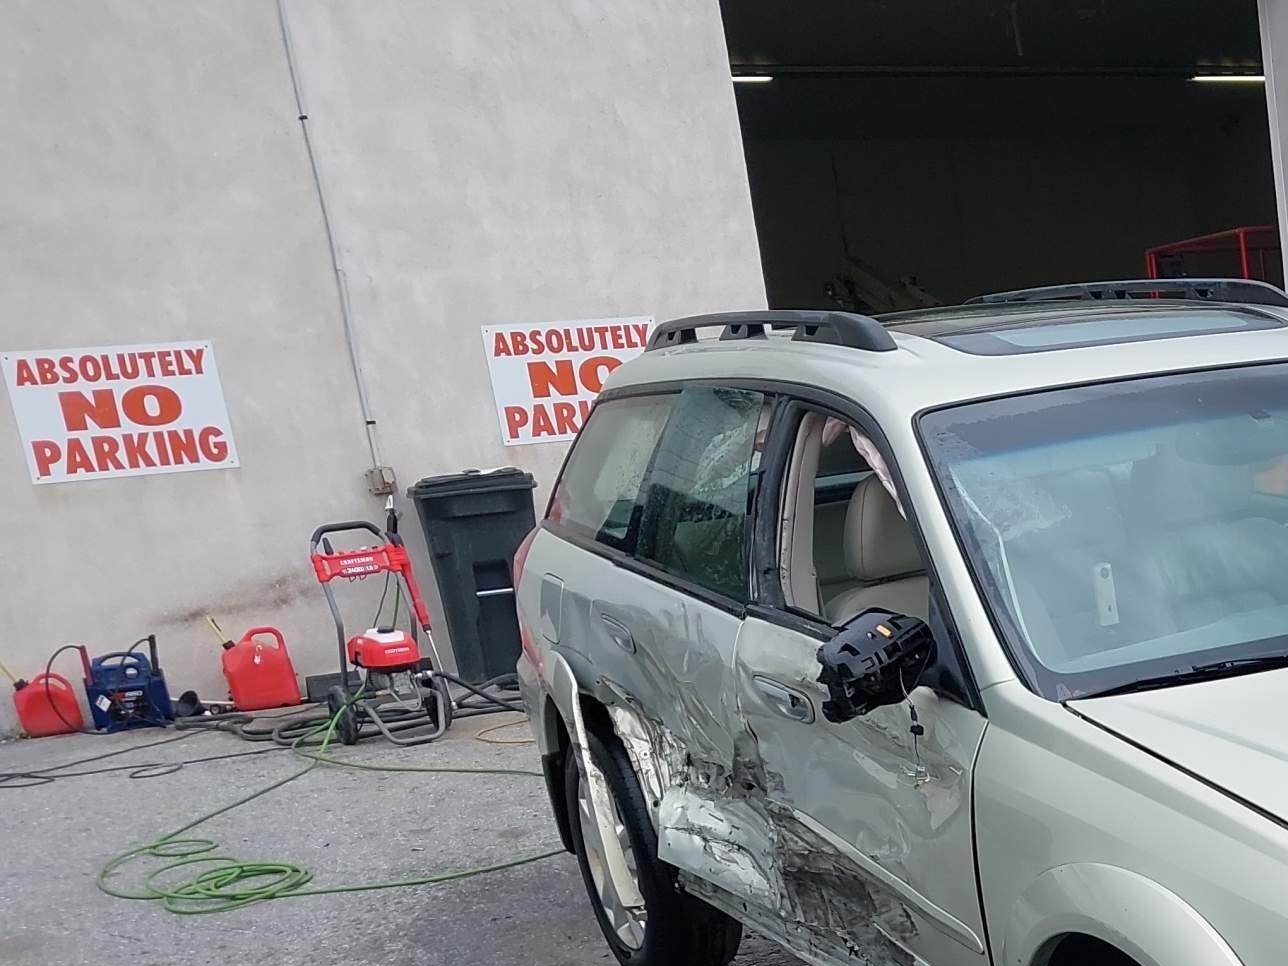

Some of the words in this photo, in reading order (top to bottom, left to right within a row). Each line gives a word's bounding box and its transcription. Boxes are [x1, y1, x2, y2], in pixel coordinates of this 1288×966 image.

[494, 323, 649, 357] ABSOLUTELY
[16, 348, 205, 386] ABSOLUTELY
[58, 384, 183, 432] NO
[504, 401, 592, 439] PAR
[32, 426, 229, 477] PARKING
